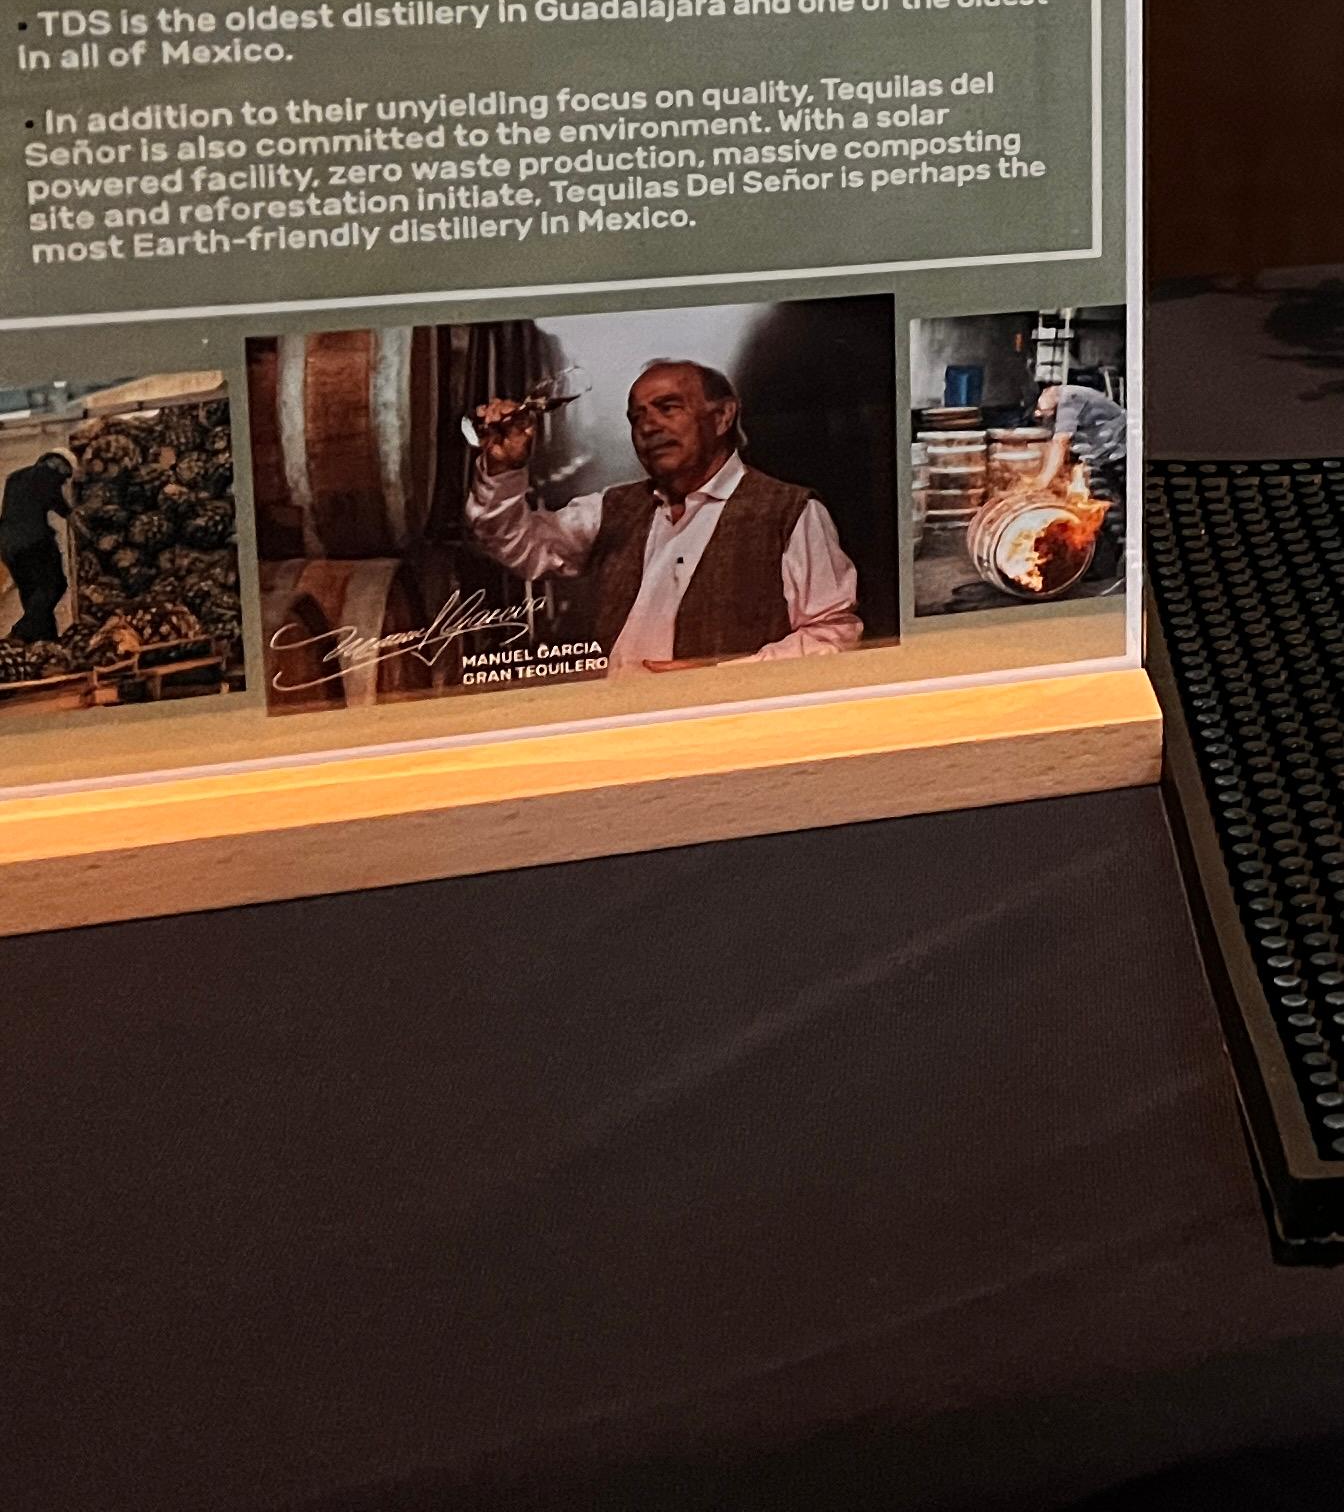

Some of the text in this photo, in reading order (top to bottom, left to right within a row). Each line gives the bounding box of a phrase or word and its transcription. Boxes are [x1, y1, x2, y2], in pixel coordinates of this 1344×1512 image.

[37, 10, 111, 36] TDS
[121, 10, 148, 34] is
[157, 8, 215, 32] the
[226, 4, 334, 31] oldest
[343, 1, 489, 28] distillery
[499, 0, 527, 23] in
[19, 38, 293, 70] in all of Mexico.
[462, 640, 602, 668] MANUEL GARCIA
[462, 657, 609, 685] GRAN TEQUILERO
